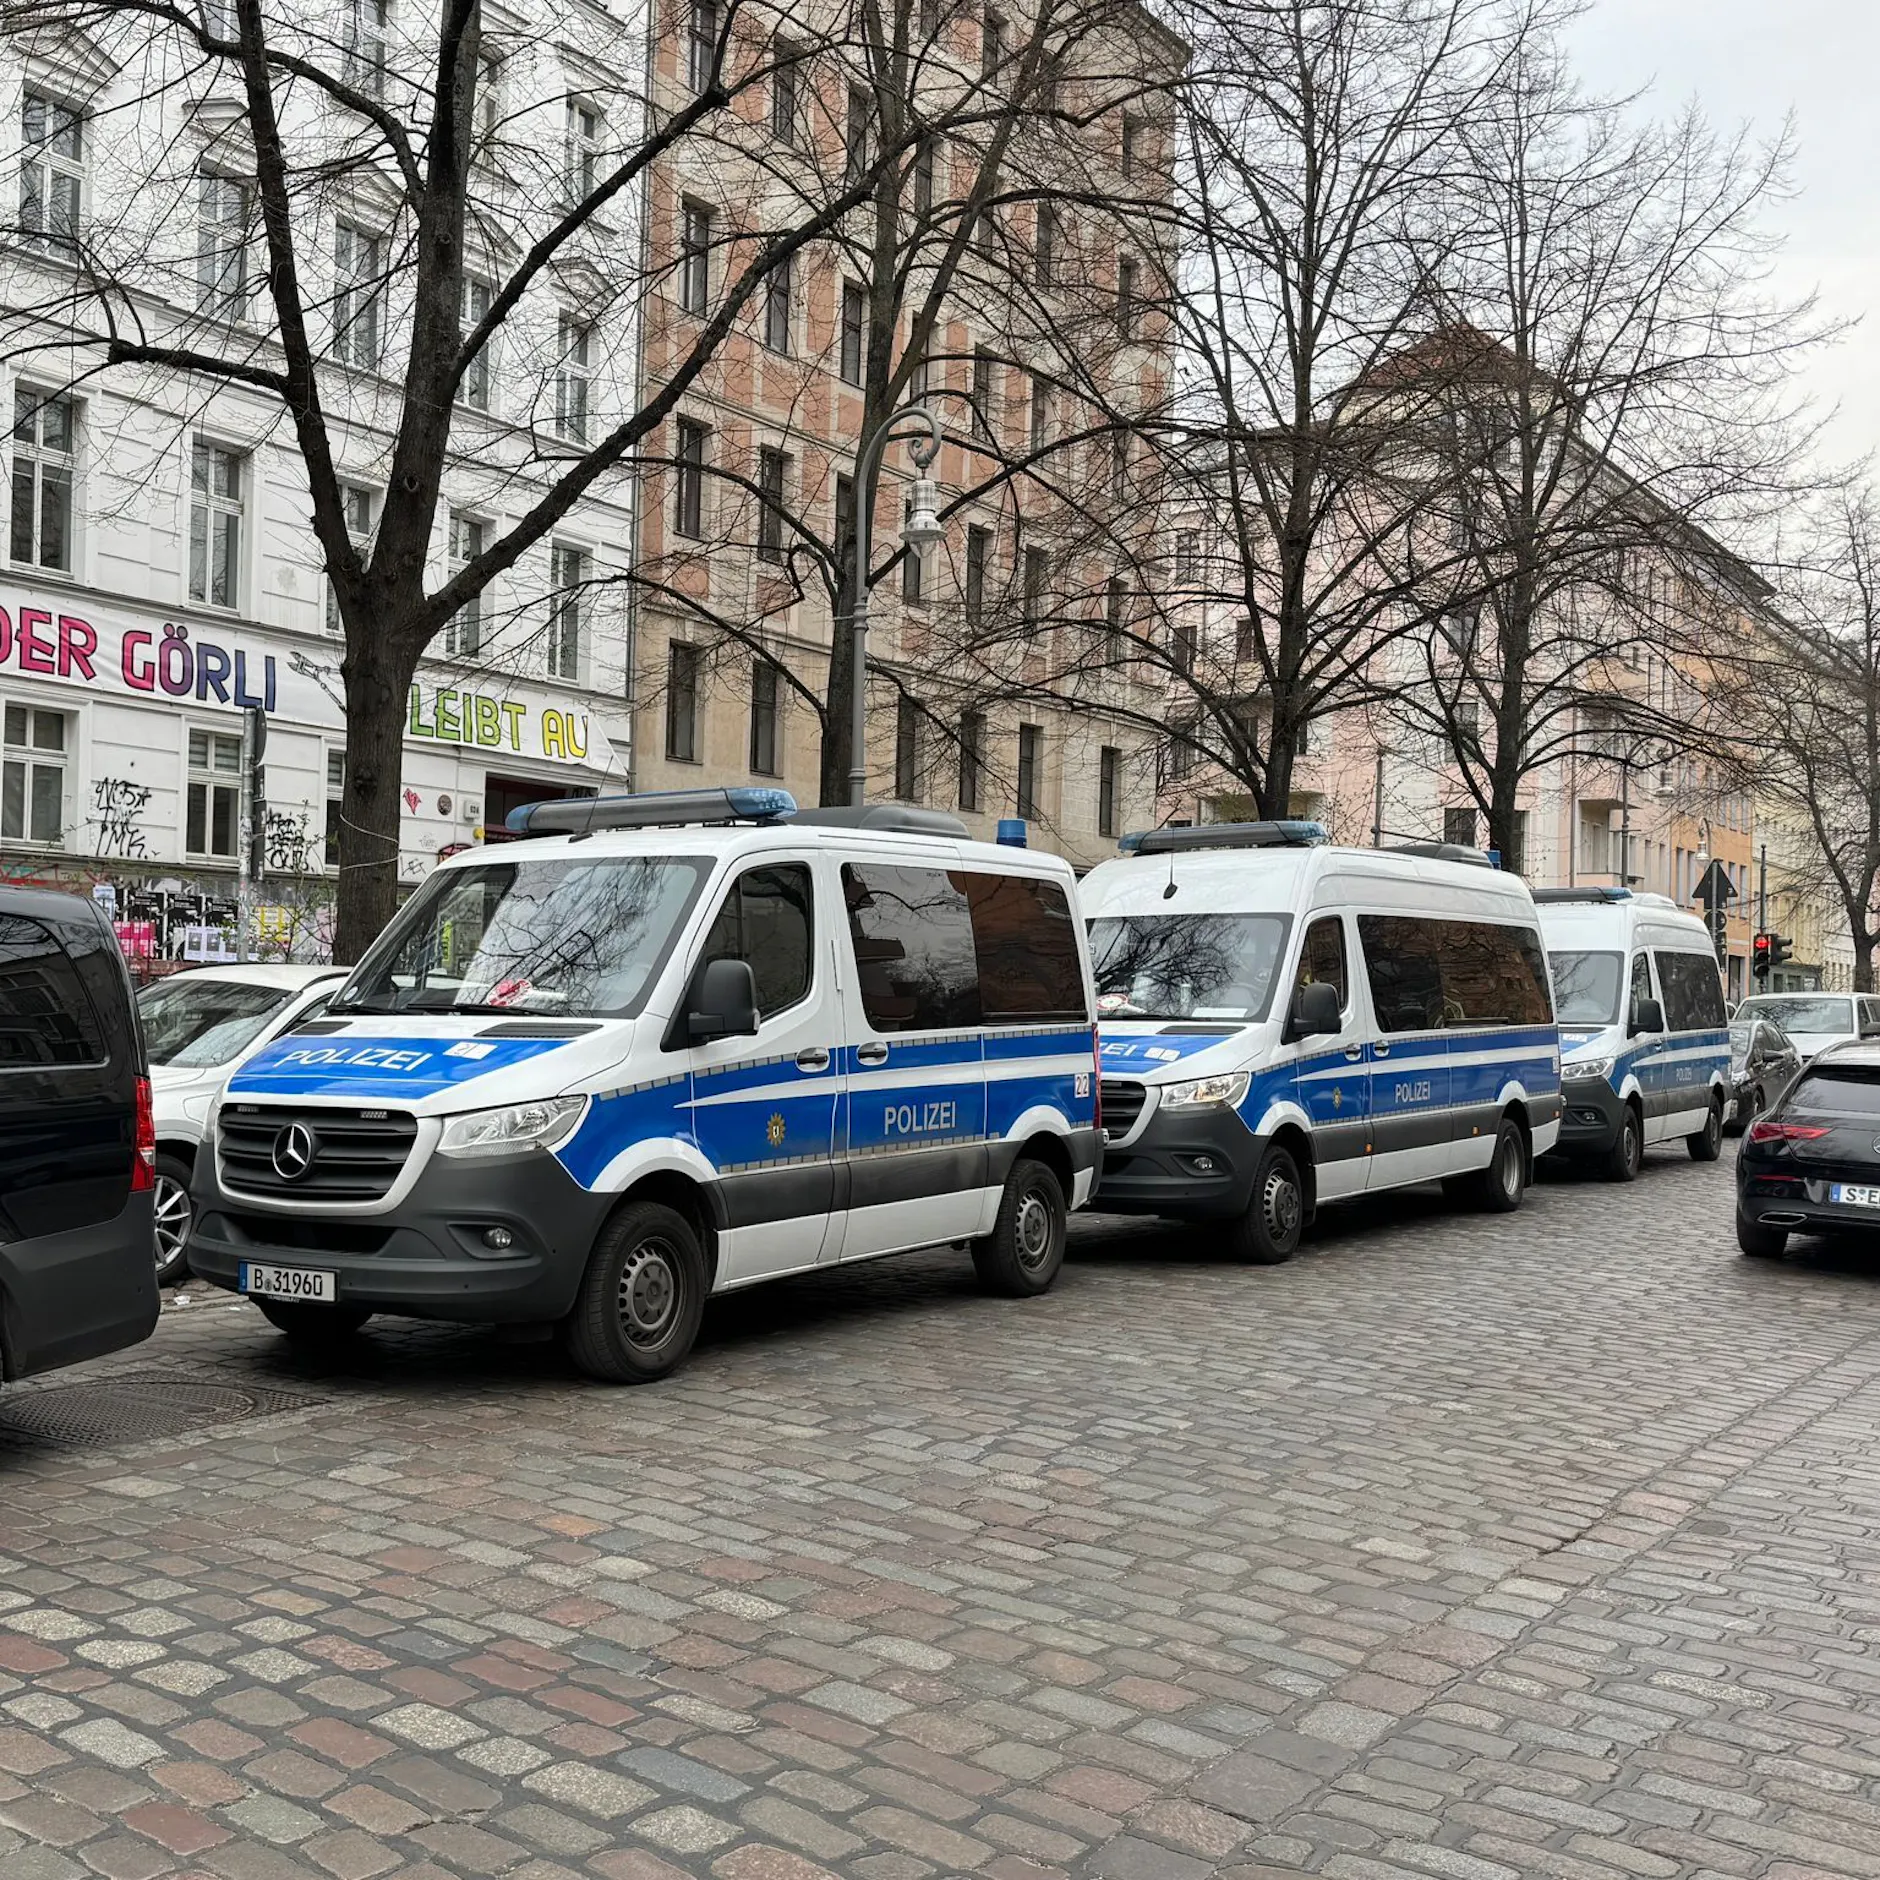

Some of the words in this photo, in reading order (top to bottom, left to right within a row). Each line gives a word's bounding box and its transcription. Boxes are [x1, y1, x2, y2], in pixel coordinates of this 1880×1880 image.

[122, 623, 276, 713] GÖRLI
[409, 683, 527, 751] LEIBT
[541, 708, 589, 759] AU
[272, 1047, 433, 1072] POLIZEI
[1076, 1075, 1088, 1095] 22
[1395, 1080, 1430, 1103] POLIZEI
[884, 1100, 956, 1136] POLIZEI
[1867, 1189, 1880, 1204] E
[273, 1270, 323, 1296] 31960
